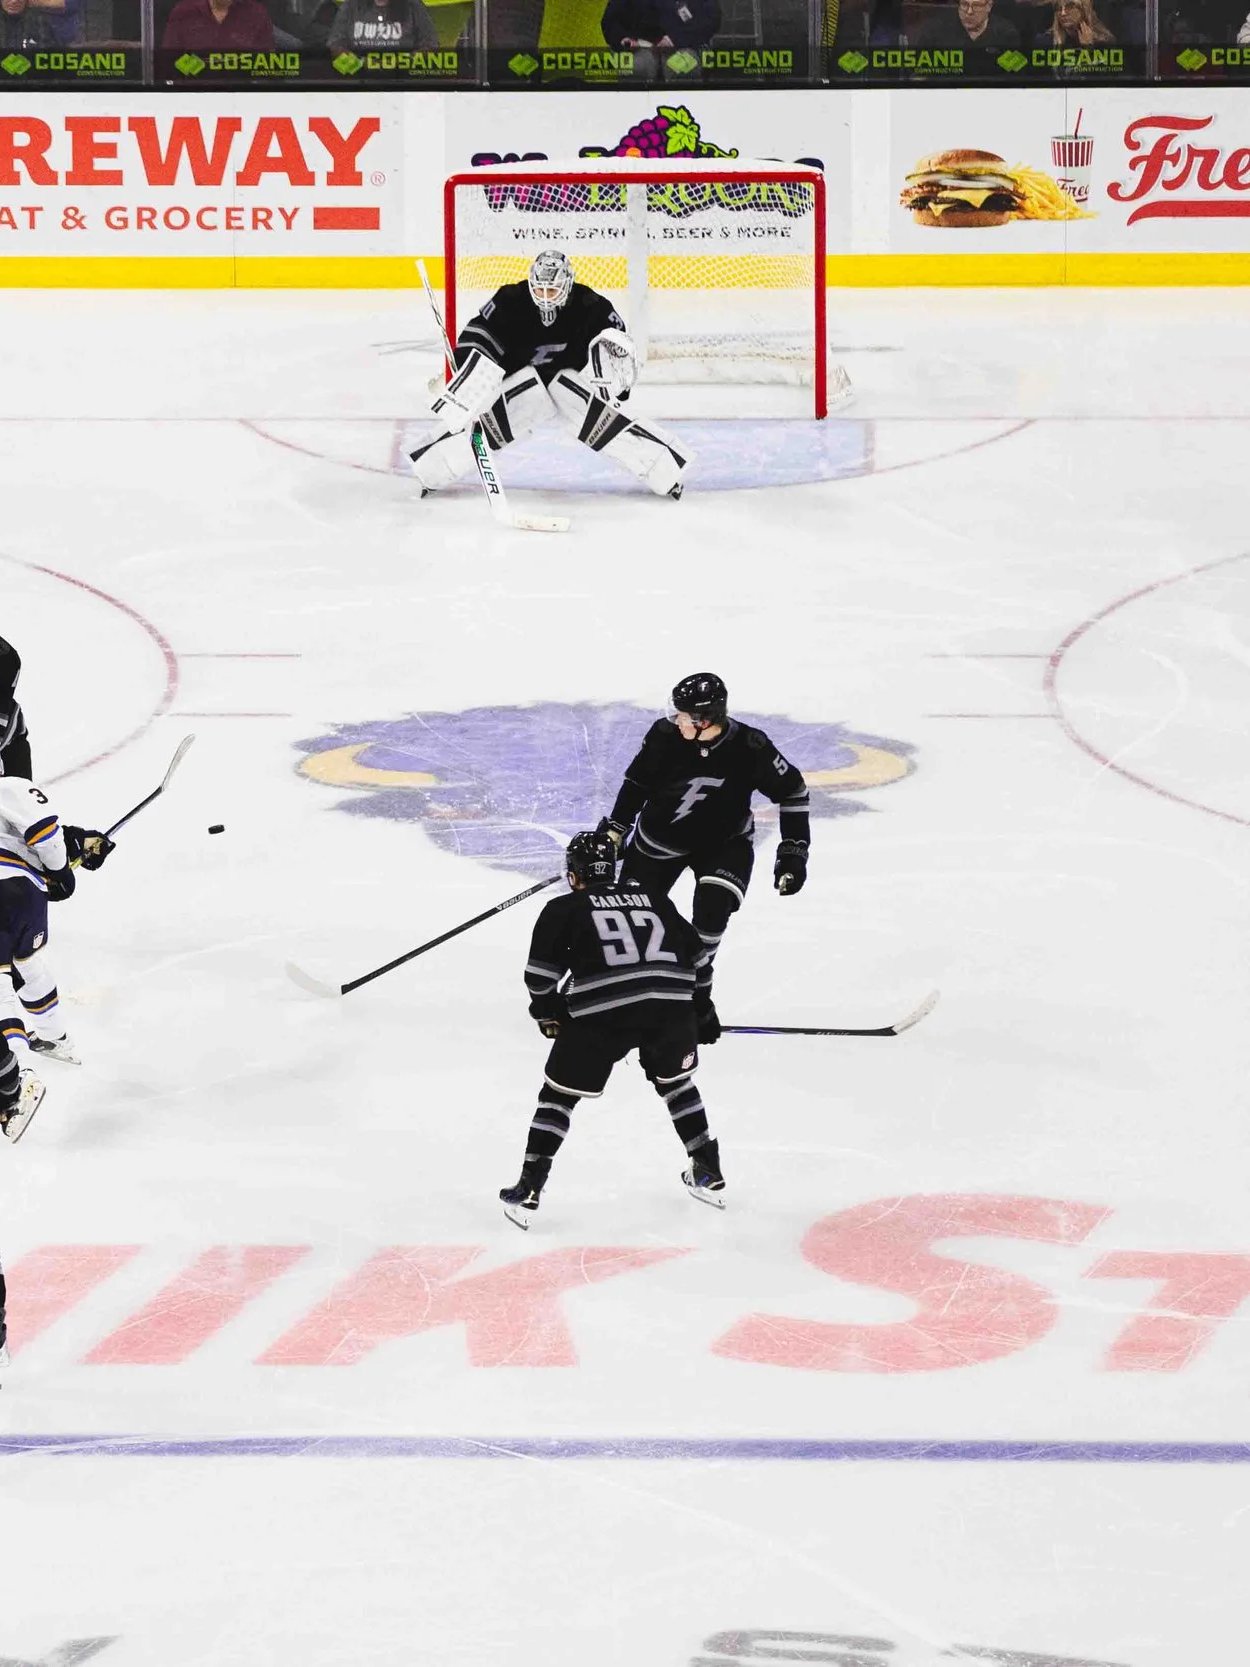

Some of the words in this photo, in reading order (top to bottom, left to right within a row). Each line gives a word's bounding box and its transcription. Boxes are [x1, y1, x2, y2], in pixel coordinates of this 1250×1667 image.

[62, 206, 87, 230] &
[105, 206, 300, 231] GROCERY
[588, 894, 653, 909] CARLSON
[590, 909, 679, 967] 92
